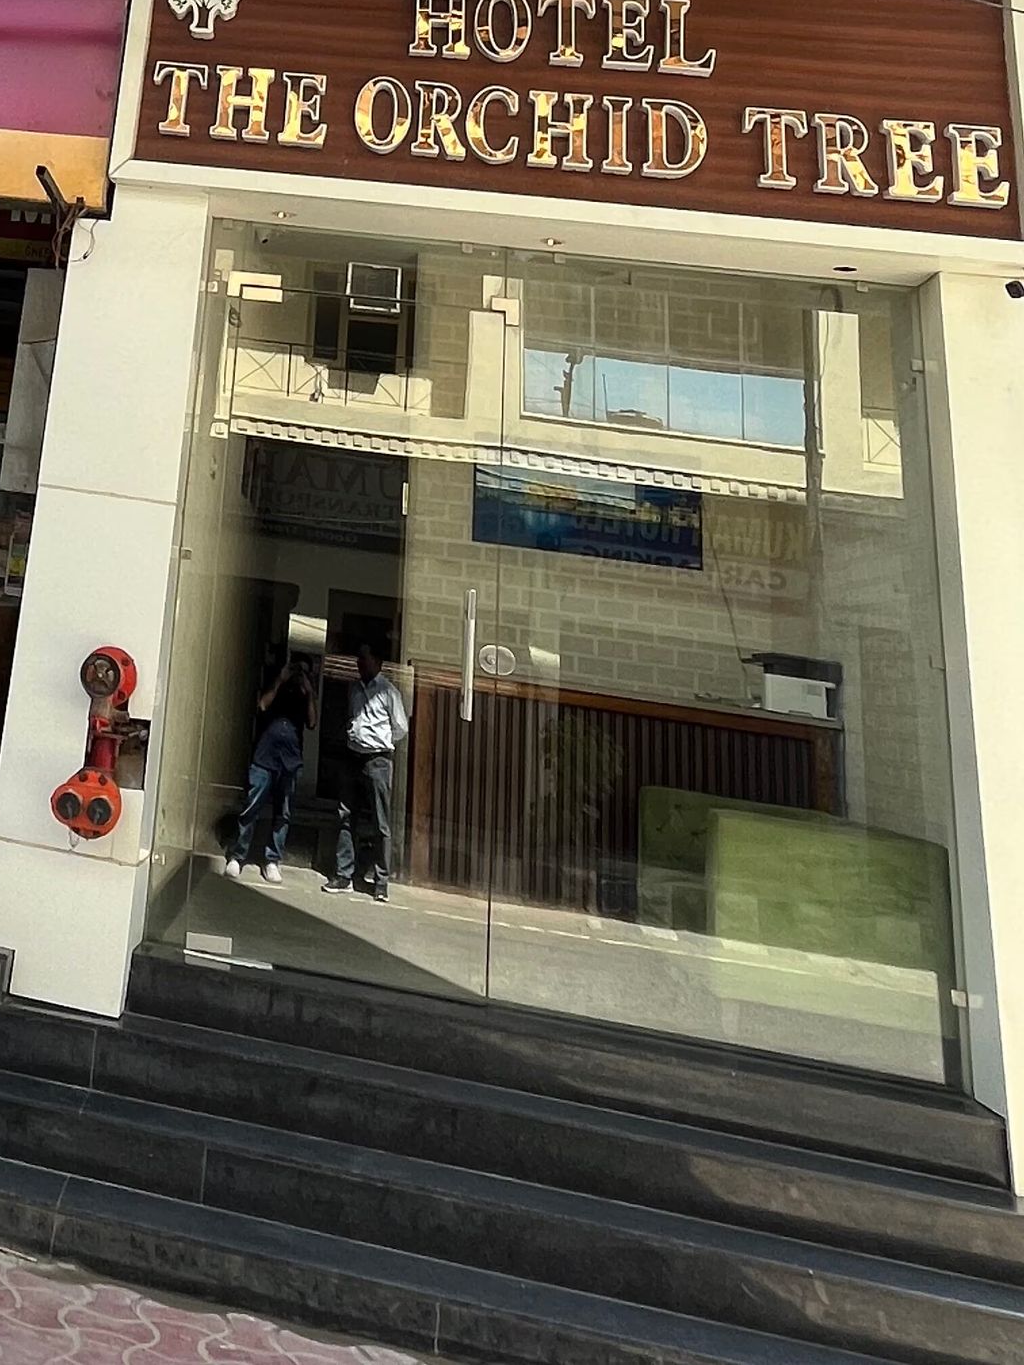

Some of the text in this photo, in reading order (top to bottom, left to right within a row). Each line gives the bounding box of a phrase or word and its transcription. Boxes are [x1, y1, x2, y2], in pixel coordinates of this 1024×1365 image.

[153, 59, 1012, 210] THE ORCHID TREE
